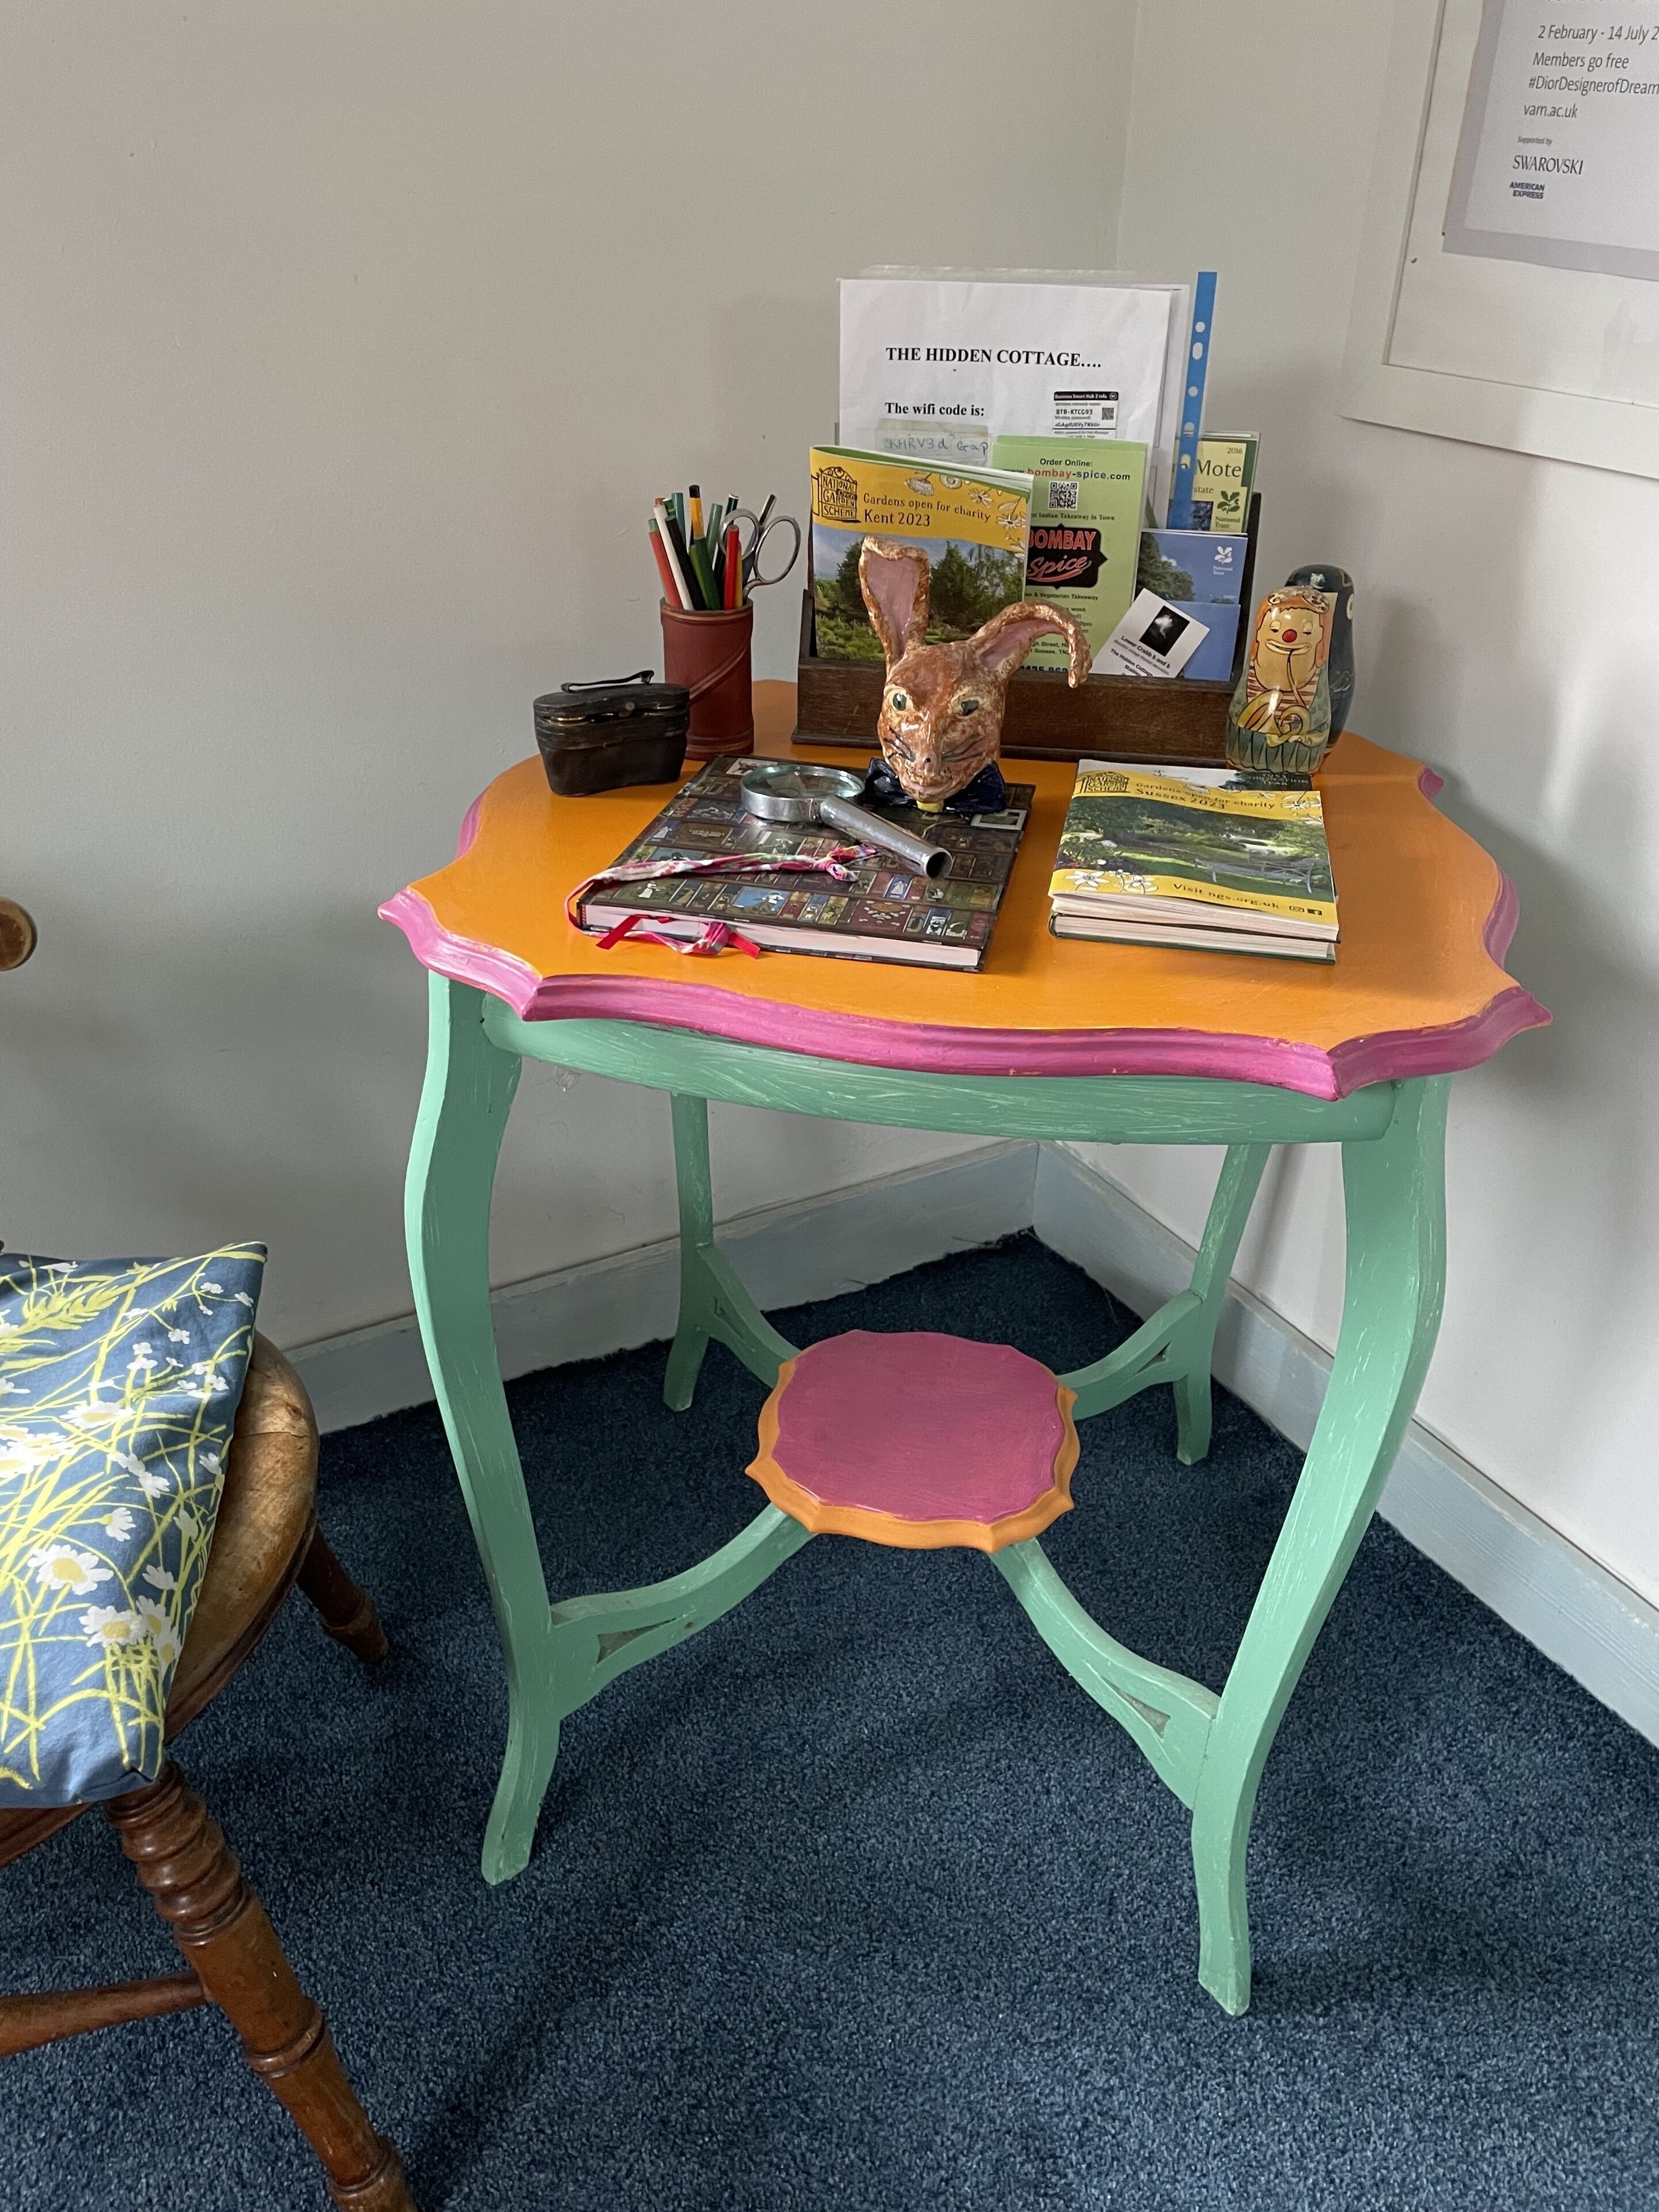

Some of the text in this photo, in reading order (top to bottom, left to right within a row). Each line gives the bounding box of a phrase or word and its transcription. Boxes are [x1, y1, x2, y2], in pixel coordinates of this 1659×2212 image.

[1537, 25, 1546, 39] 2
[1547, 24, 1598, 45] February
[1607, 25, 1623, 40] 14
[1624, 25, 1649, 46] July
[1532, 52, 1630, 72] Members go free
[1523, 103, 1578, 119] vam.ac.uk
[1512, 154, 1584, 175] SWAROVSKI
[1509, 181, 1545, 191] AMERICAN
[1512, 190, 1544, 199] EXPRESS
[885, 347, 1102, 368] THE HIDDEN COTTAGE....
[885, 402, 985, 416] The wifi code is:
[957, 440, 989, 456] Gap
[1226, 446, 1243, 455] 2016
[1040, 458, 1062, 466] Order
[1196, 459, 1241, 478] Mote
[823, 475, 855, 494] NATIONAL
[1194, 486, 1214, 494] state
[823, 505, 855, 517] SCHEME
[863, 493, 905, 507] Gardens
[908, 500, 933, 510] open
[935, 501, 951, 512] for
[954, 505, 991, 523] charity
[865, 508, 931, 527] Kent 2023
[1060, 513, 1089, 521] Takeaway
[1027, 554, 1089, 578] Spice
[1136, 787, 1186, 802] Sussex
[1136, 782, 1275, 810] Gardens open for charity
[1173, 883, 1280, 909] Visit ngs.org.uk
